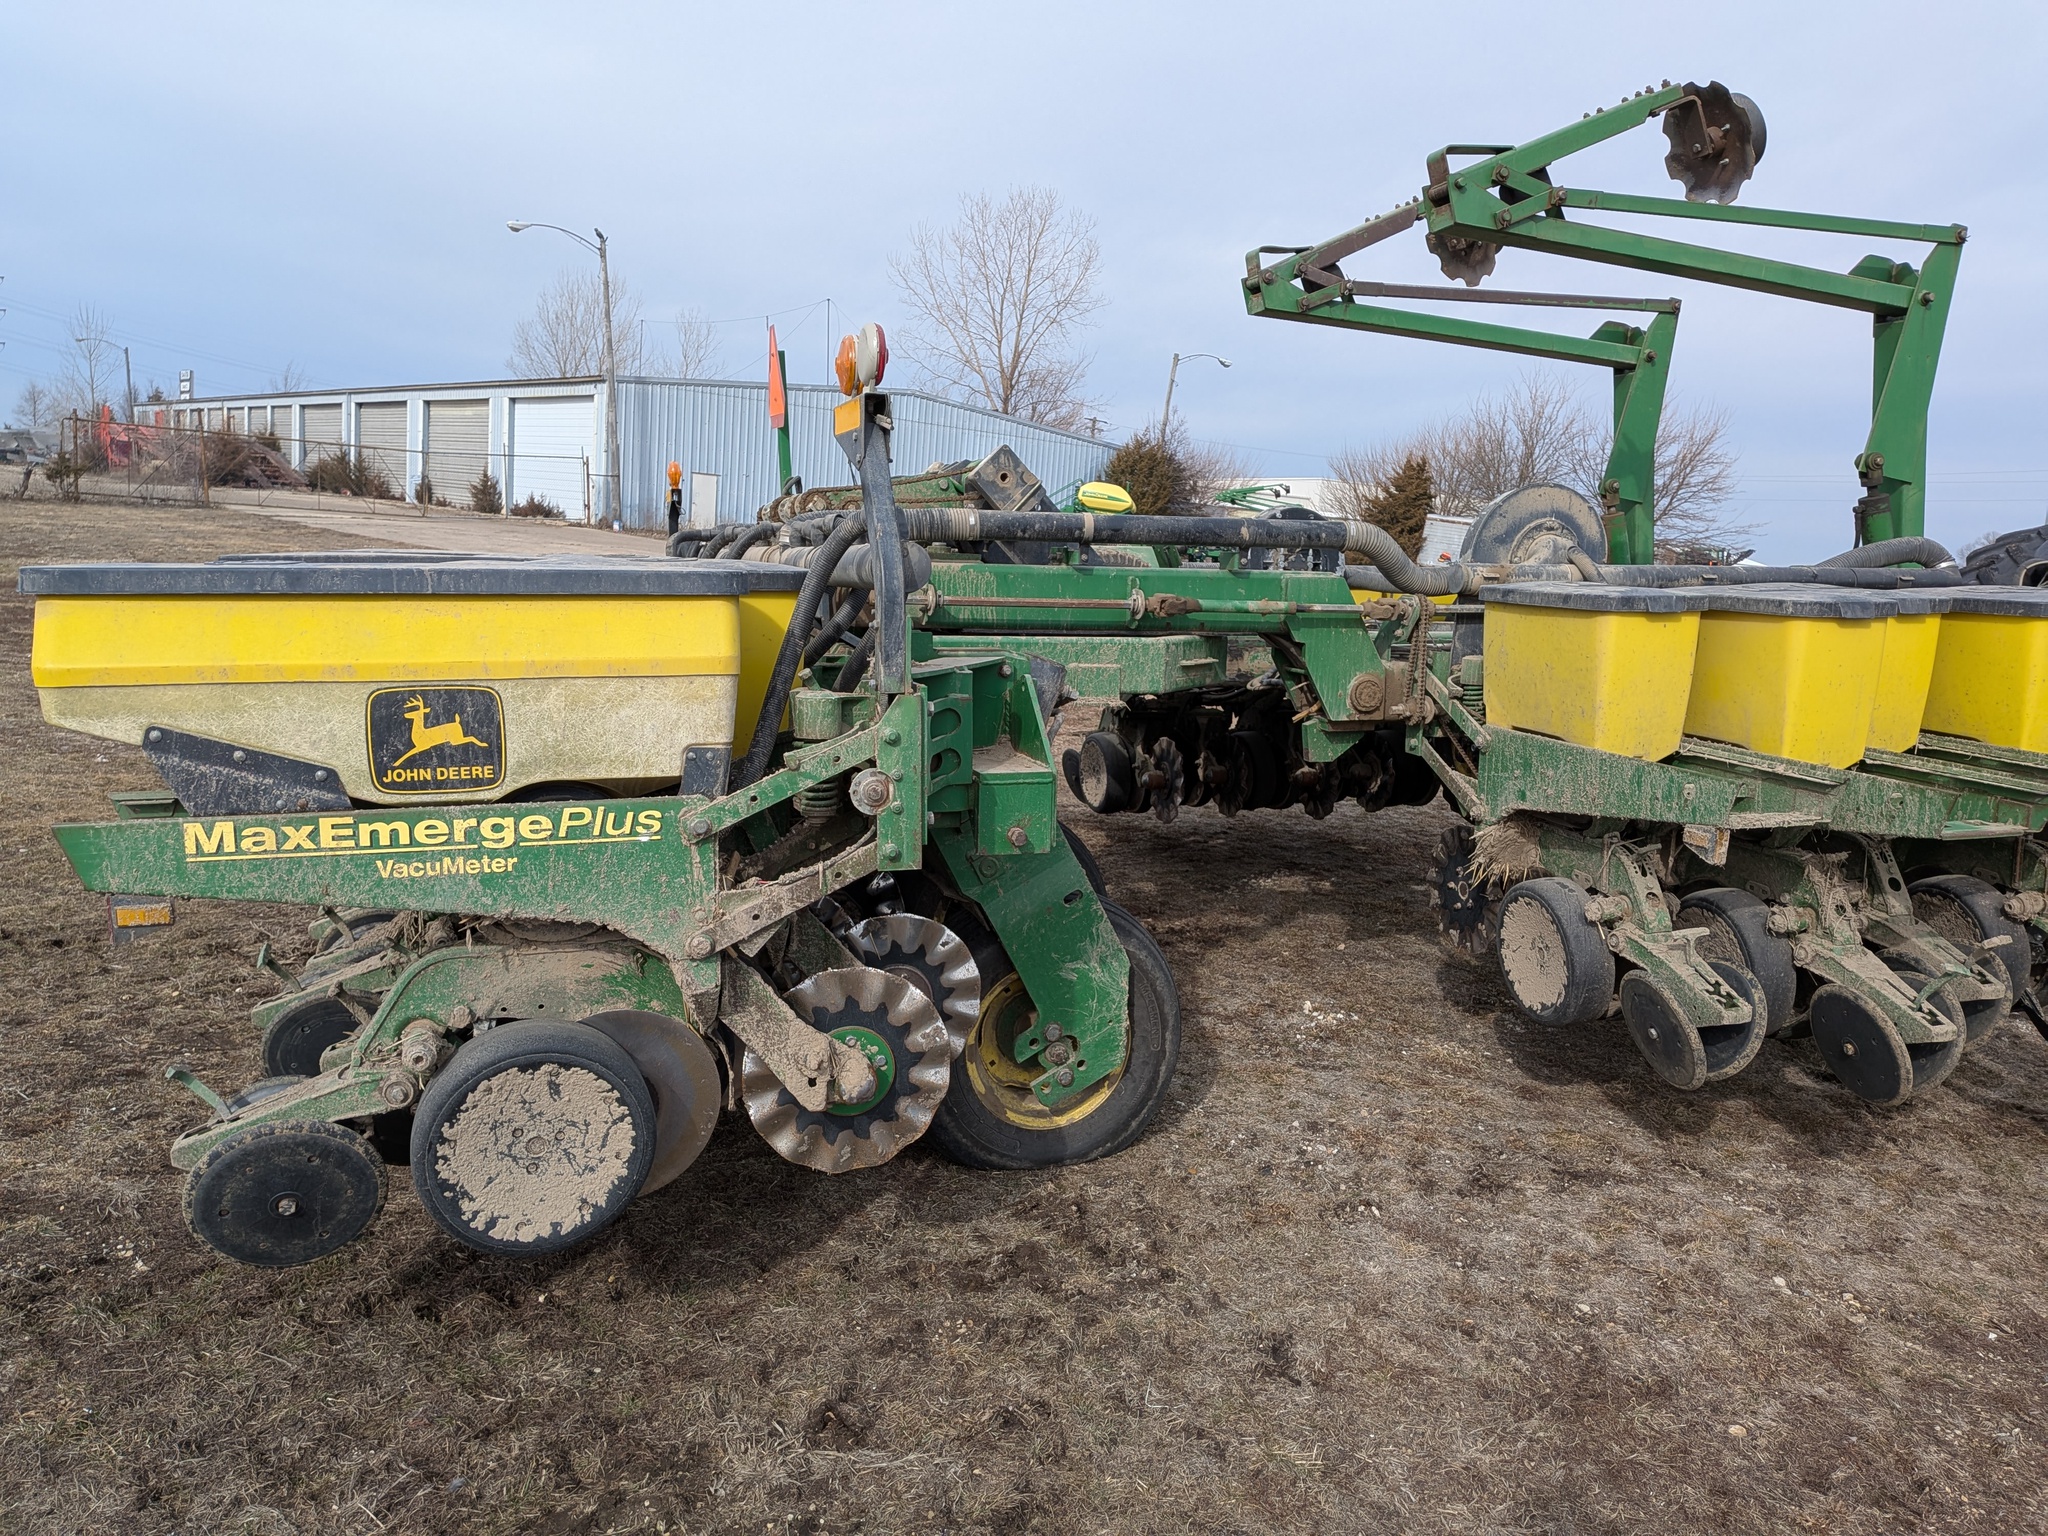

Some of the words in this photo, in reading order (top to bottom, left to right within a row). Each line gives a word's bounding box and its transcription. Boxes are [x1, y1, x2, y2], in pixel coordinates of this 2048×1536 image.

[382, 767, 432, 783] JOHN
[436, 765, 495, 780] DEERE
[375, 854, 518, 879] VacuMeter
